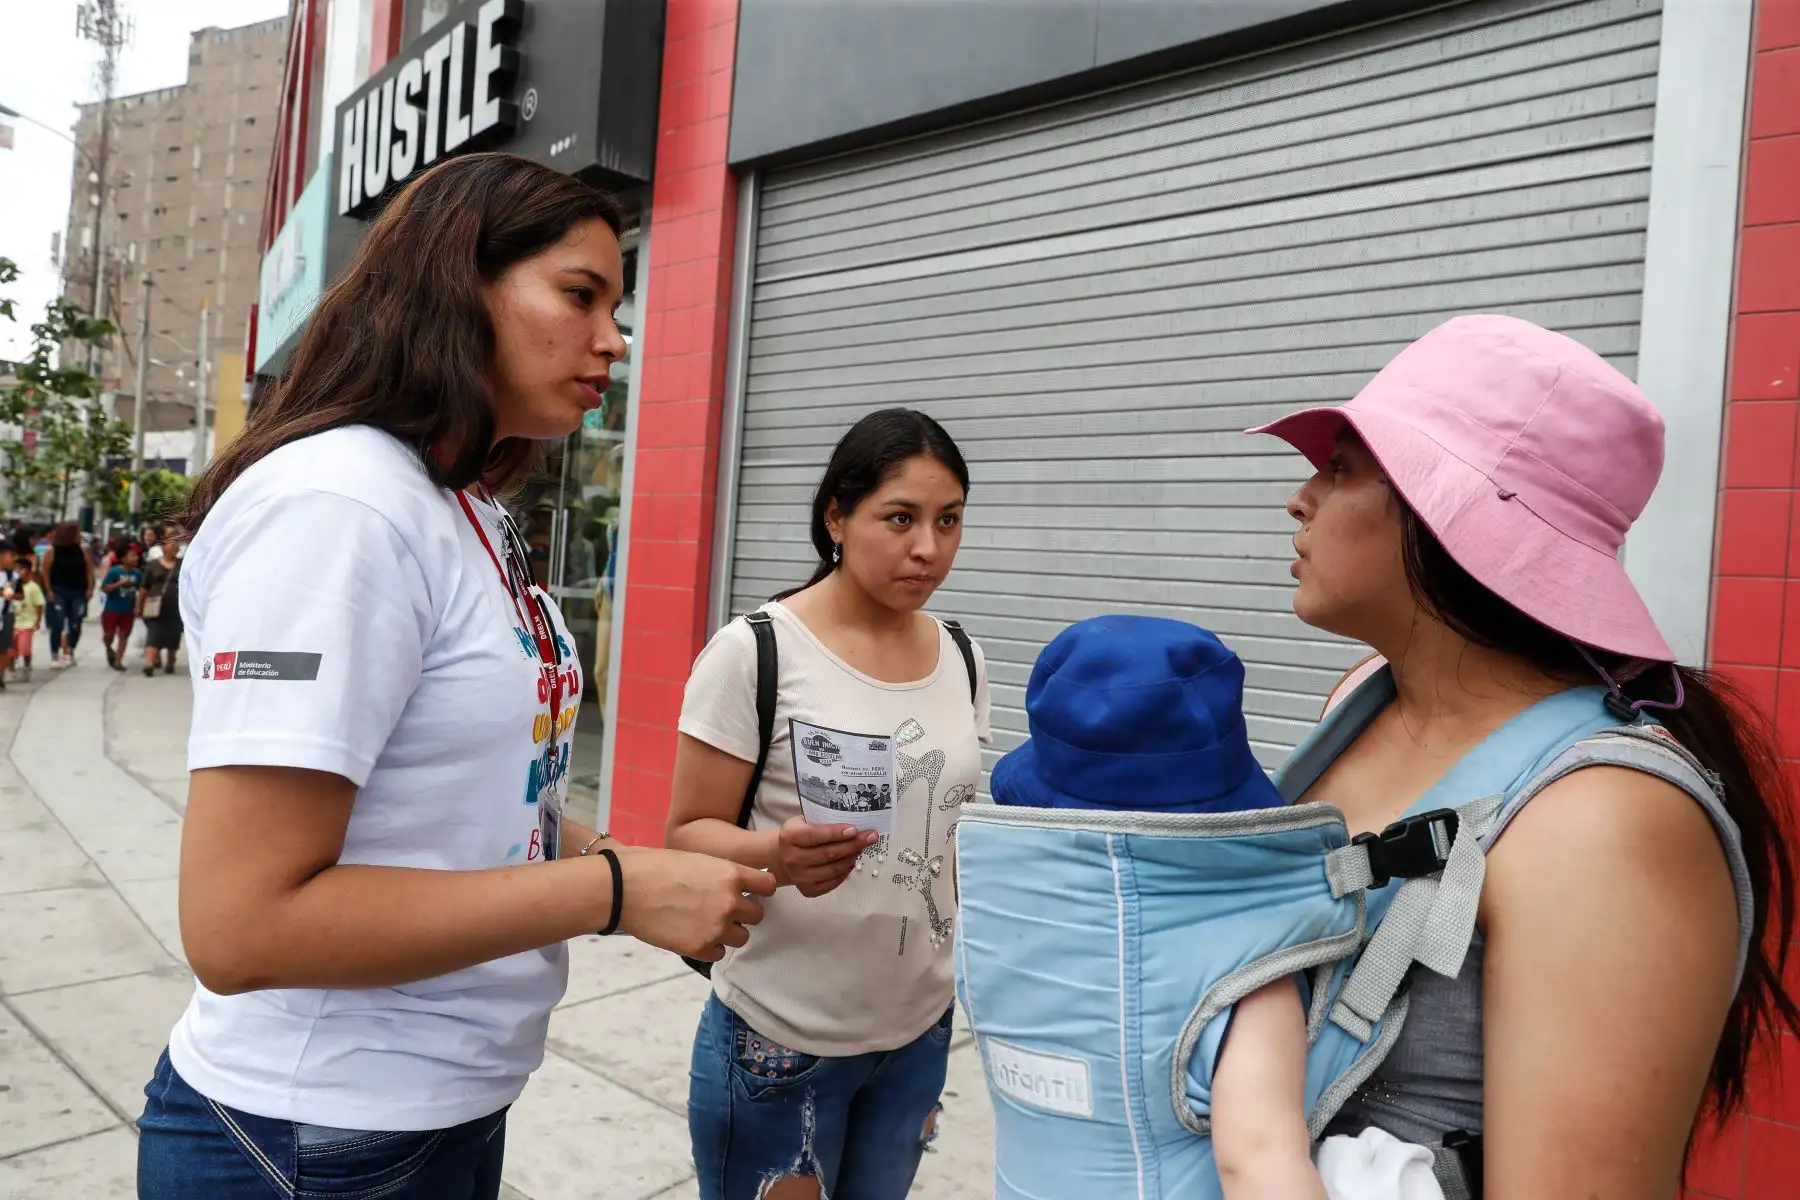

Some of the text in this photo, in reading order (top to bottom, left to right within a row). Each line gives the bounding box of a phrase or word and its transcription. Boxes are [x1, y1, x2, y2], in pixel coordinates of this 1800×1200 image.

[339, 0, 506, 216] HUSTLE
[534, 615, 547, 640] DRELM
[216, 661, 232, 672] PERÚ
[239, 661, 272, 669] Ministerio
[246, 668, 279, 677] Educación
[803, 738, 820, 747] BUEN
